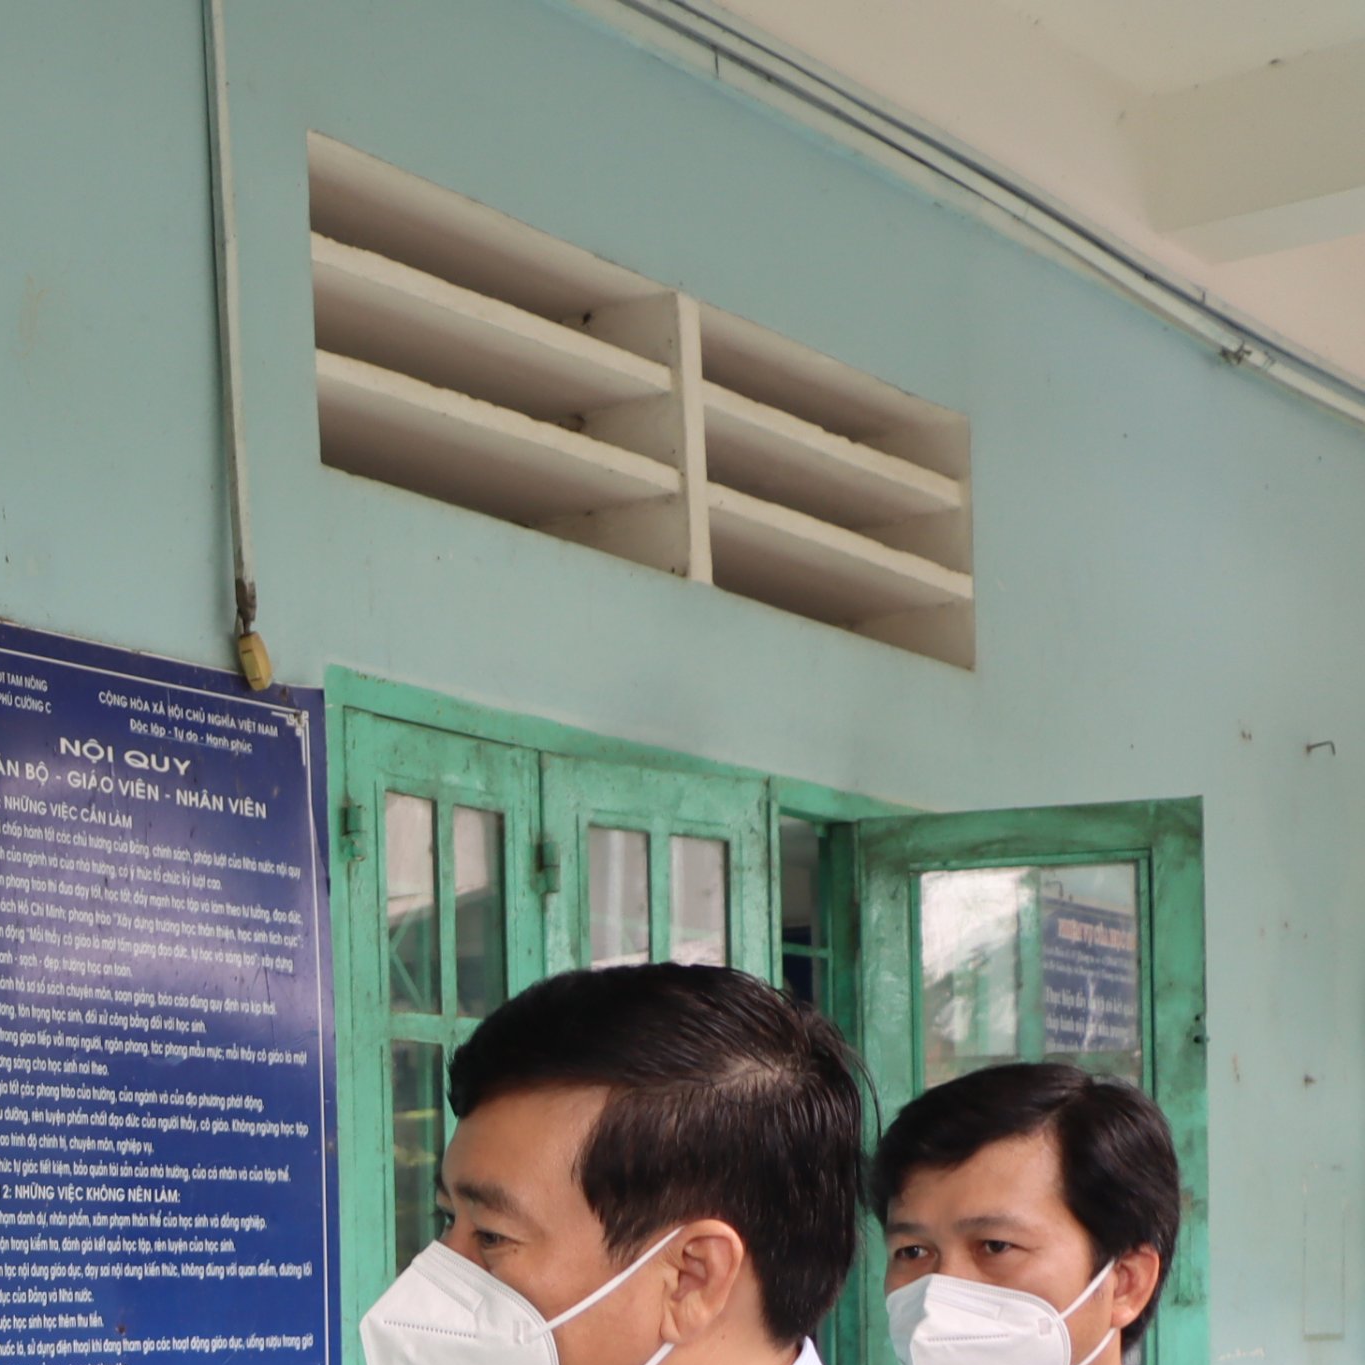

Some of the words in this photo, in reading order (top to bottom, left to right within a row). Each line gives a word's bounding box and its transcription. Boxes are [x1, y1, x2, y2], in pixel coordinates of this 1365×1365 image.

[98, 689, 128, 708] CỘNG
[129, 697, 151, 713] HÒA
[167, 703, 184, 721] HỘI
[185, 707, 206, 724] CHỦ
[237, 717, 256, 734] VIỆT
[257, 722, 279, 737] NAM
[59, 736, 114, 764] NỘI
[124, 750, 191, 776] QUY
[25, 760, 49, 786] BỘ
[66, 769, 114, 794] GIÁO
[118, 778, 159, 802] VIÊN
[176, 788, 224, 812] NHÂN
[228, 796, 267, 819] VIÊN
[4, 795, 47, 816] NHỮNG
[49, 801, 78, 822] VIỆC
[80, 804, 106, 825] CẦN
[108, 809, 133, 829] LÀM
[2, 1184, 12, 1199] 2:
[14, 1181, 55, 1200] NHỮNG
[57, 1183, 84, 1204] VIỆC
[86, 1183, 125, 1202] KHÔNG
[128, 1184, 152, 1203] NÊN
